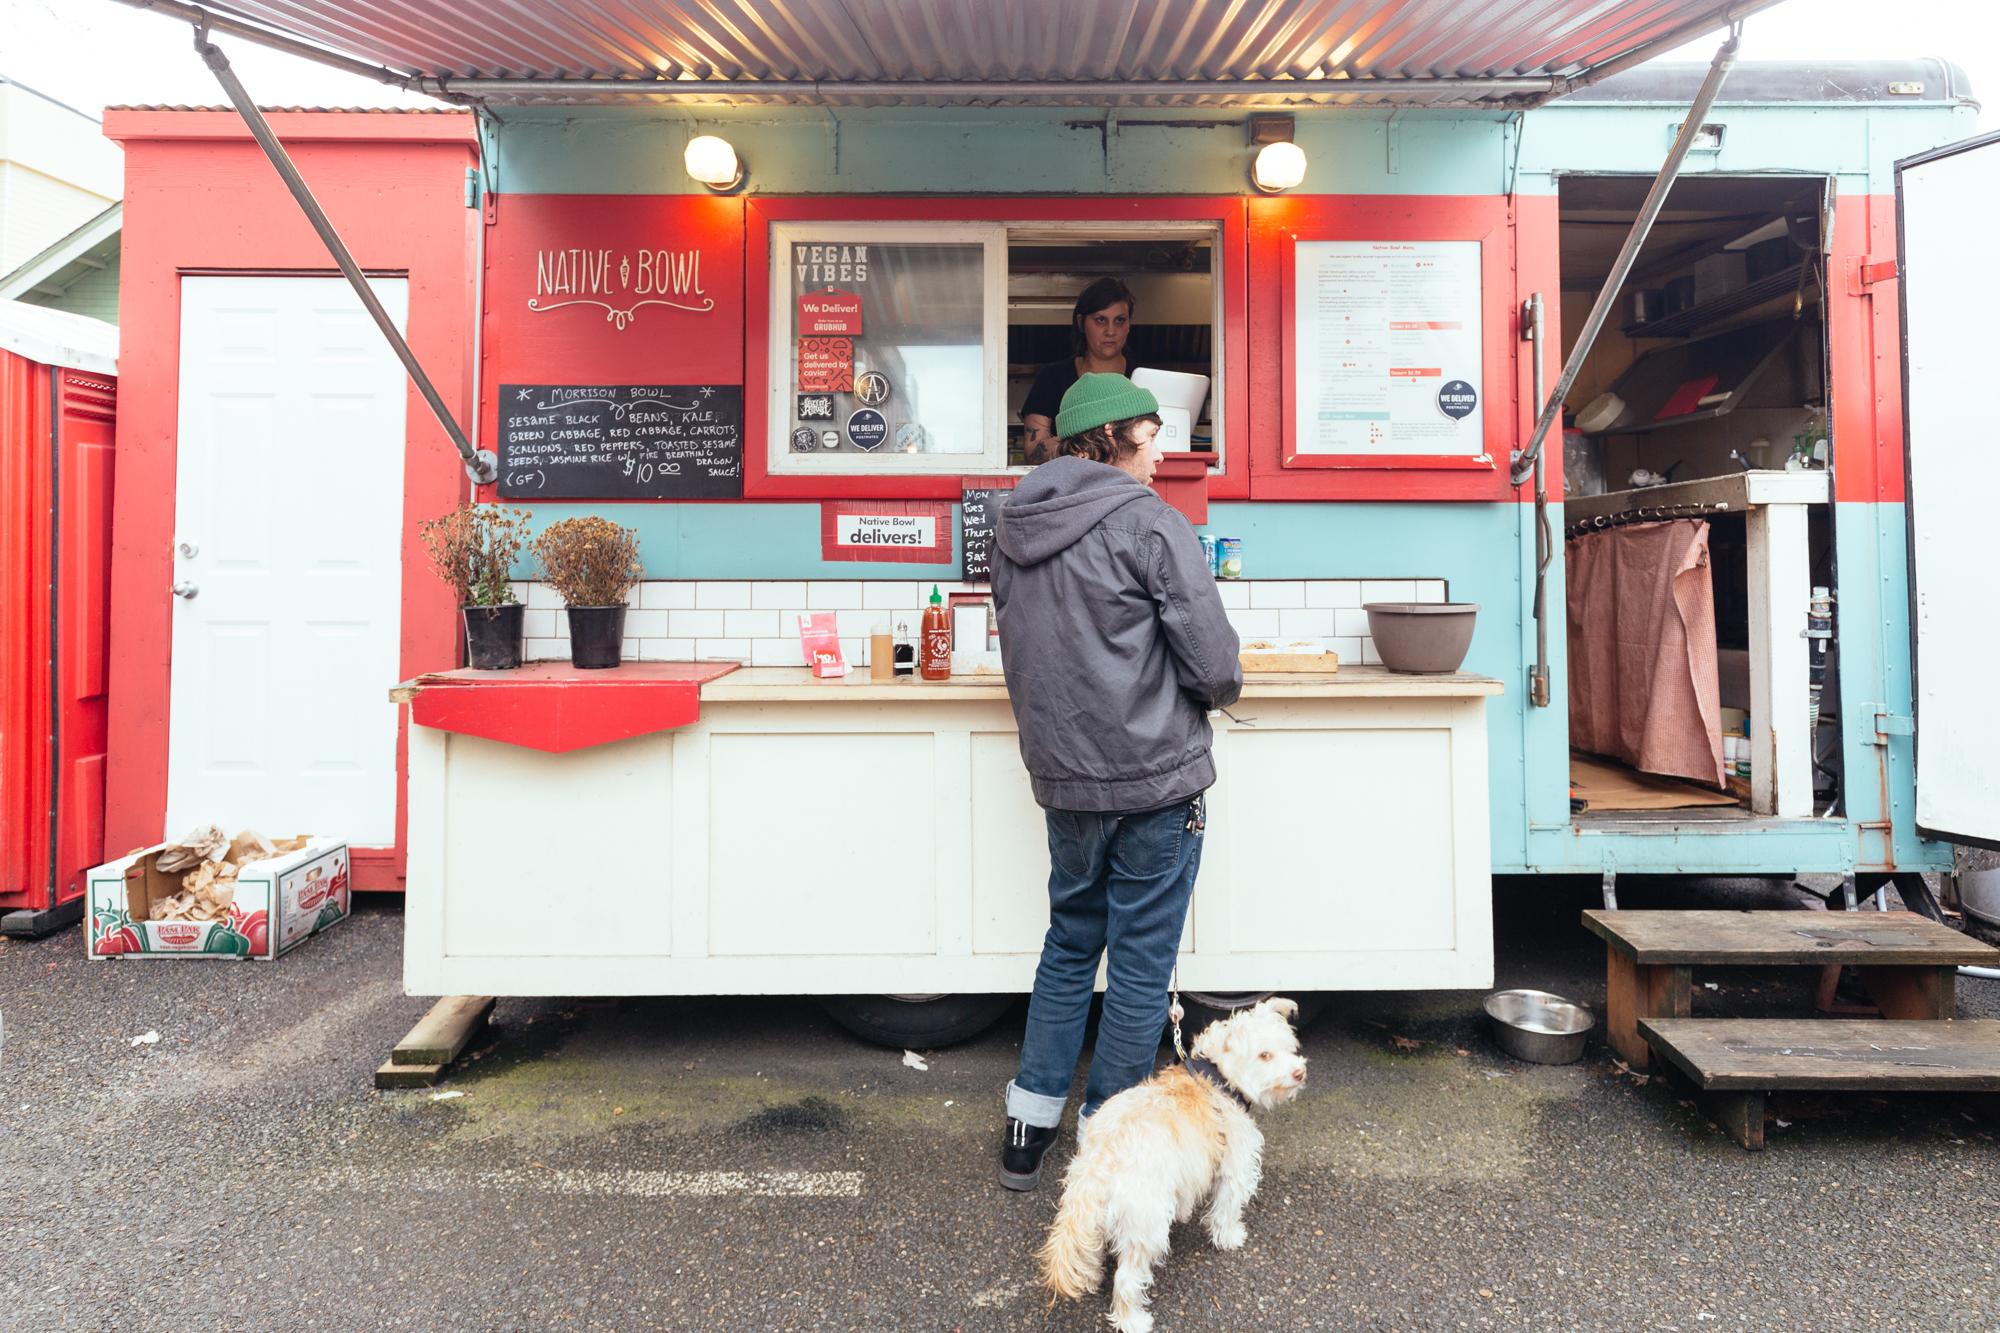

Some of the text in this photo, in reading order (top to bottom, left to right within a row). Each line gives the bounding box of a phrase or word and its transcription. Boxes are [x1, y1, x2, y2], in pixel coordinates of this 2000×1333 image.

[796, 246, 868, 263] VEGAN
[537, 249, 705, 296] NATIVE BOWL
[796, 264, 868, 282] VIBES
[803, 303, 858, 313] We Deliver!
[814, 323, 848, 331] GRUBHUB
[803, 352, 818, 360] Get
[803, 361, 849, 370] delivered by
[551, 387, 672, 403] MORRISON BOWL
[1440, 394, 1475, 403] WE DELIVER
[565, 414, 600, 425] BLACK
[628, 411, 674, 426] BEANS,
[681, 410, 719, 424] KALE,
[509, 424, 739, 443] GREEN CABBAGE, RED CABBAGE, CARROTS,
[850, 423, 884, 432] WE DELIVER
[507, 443, 568, 456] SCALLIONS,
[574, 443, 596, 453] RED
[600, 440, 650, 452] PEPPERS,
[654, 440, 699, 451] TOASTED
[507, 455, 543, 467] SEEDS,
[549, 455, 588, 465] JASMINE
[590, 452, 613, 464] RICE
[665, 448, 714, 460] BREATHING
[696, 456, 733, 466] DRAGON
[707, 461, 740, 478] SAUCE!
[506, 469, 546, 489] (GF)
[963, 502, 984, 513] Tues
[859, 517, 916, 527] Native Bowl
[963, 513, 986, 527] Wed
[850, 528, 922, 545] delivers!
[964, 528, 995, 538] Thurs
[967, 539, 986, 550] Fri
[965, 551, 987, 563] Sat
[966, 564, 991, 575] Sun
